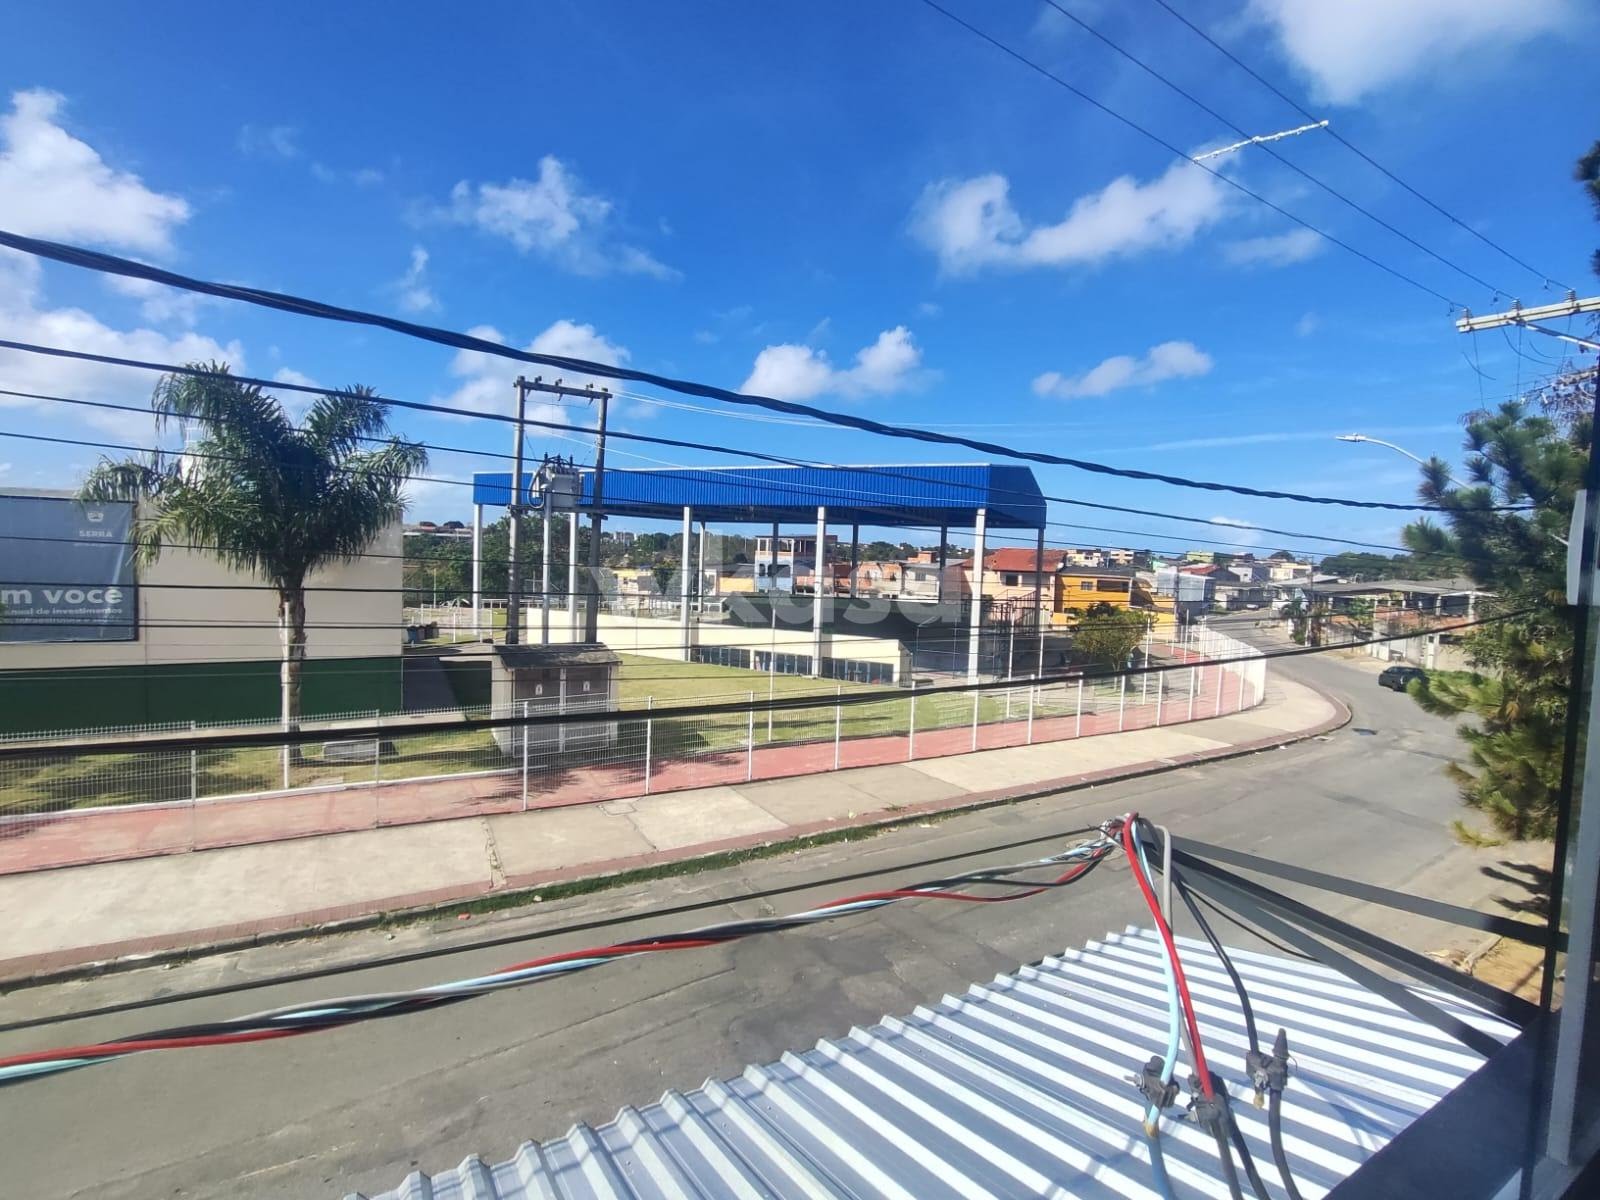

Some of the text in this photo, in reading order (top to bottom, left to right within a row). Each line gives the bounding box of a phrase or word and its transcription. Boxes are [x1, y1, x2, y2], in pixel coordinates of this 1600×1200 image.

[0, 589, 33, 604] m
[36, 607, 50, 615] de
[52, 606, 123, 615] investimentos
